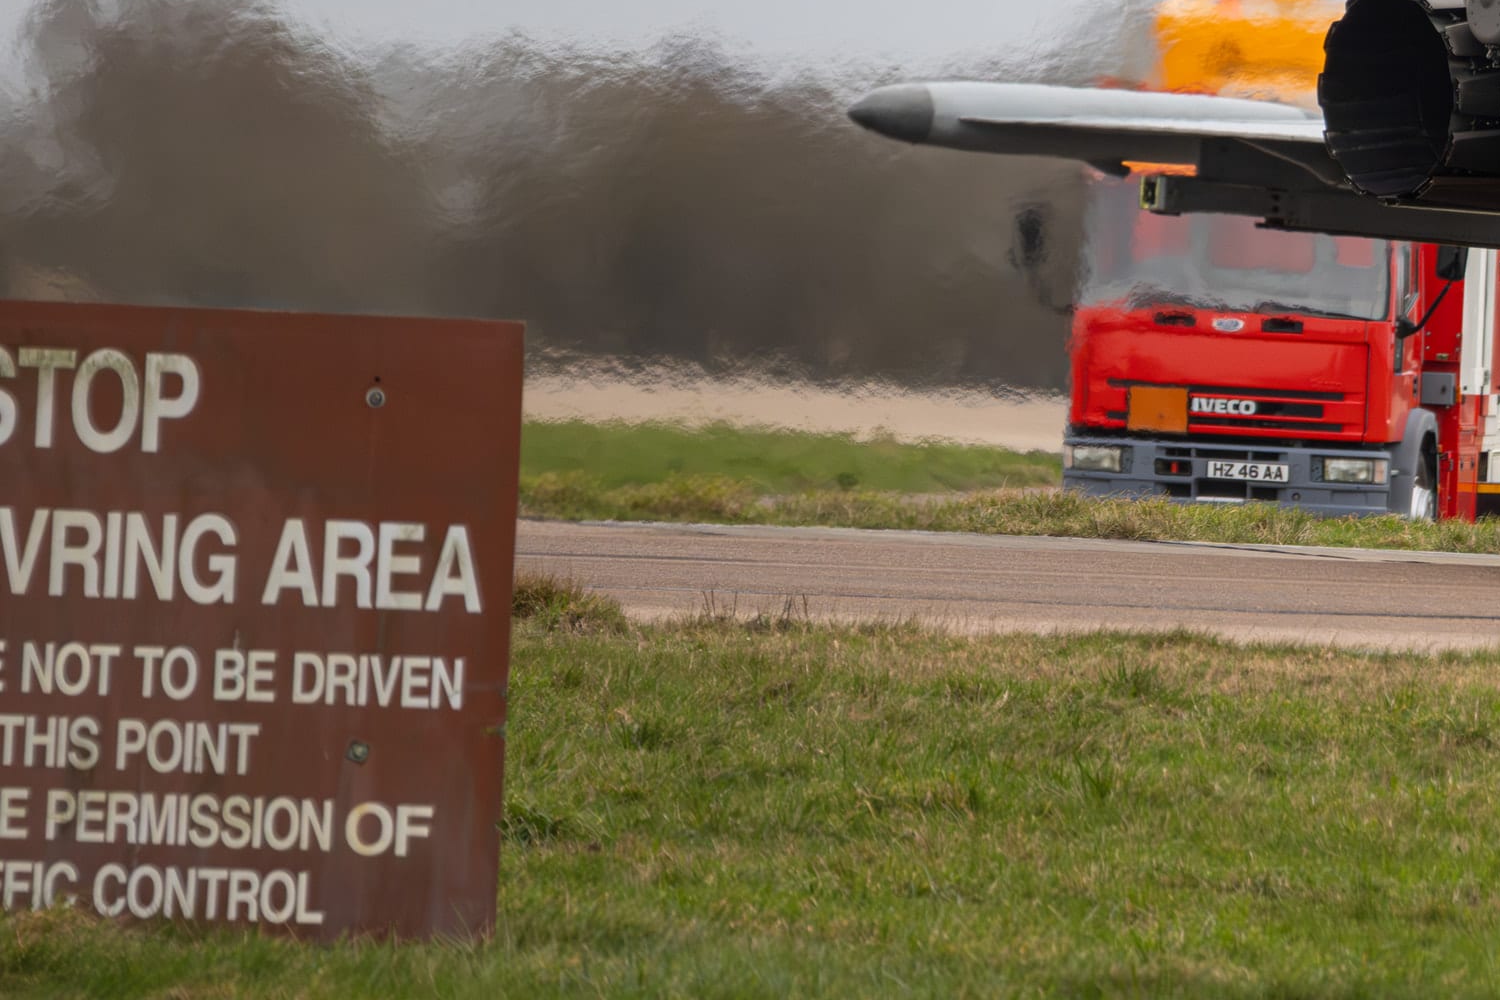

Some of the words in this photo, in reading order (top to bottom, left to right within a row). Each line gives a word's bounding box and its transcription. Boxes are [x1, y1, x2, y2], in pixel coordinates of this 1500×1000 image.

[1191, 397, 1257, 415] IVECO
[1212, 463, 1235, 479] HZ
[1237, 465, 1260, 479] 46
[1262, 466, 1283, 482] AA
[261, 518, 482, 614] AREA
[20, 642, 120, 697] NOT
[134, 647, 197, 700] TO
[213, 650, 277, 703] BE
[292, 652, 464, 710] DRIVEN
[0, 715, 100, 771] THIS
[116, 720, 260, 775] POINT
[45, 790, 333, 852] PERMISSION
[345, 803, 434, 857] OF
[0, 861, 78, 912] FIC
[92, 863, 324, 925] CONTROL
